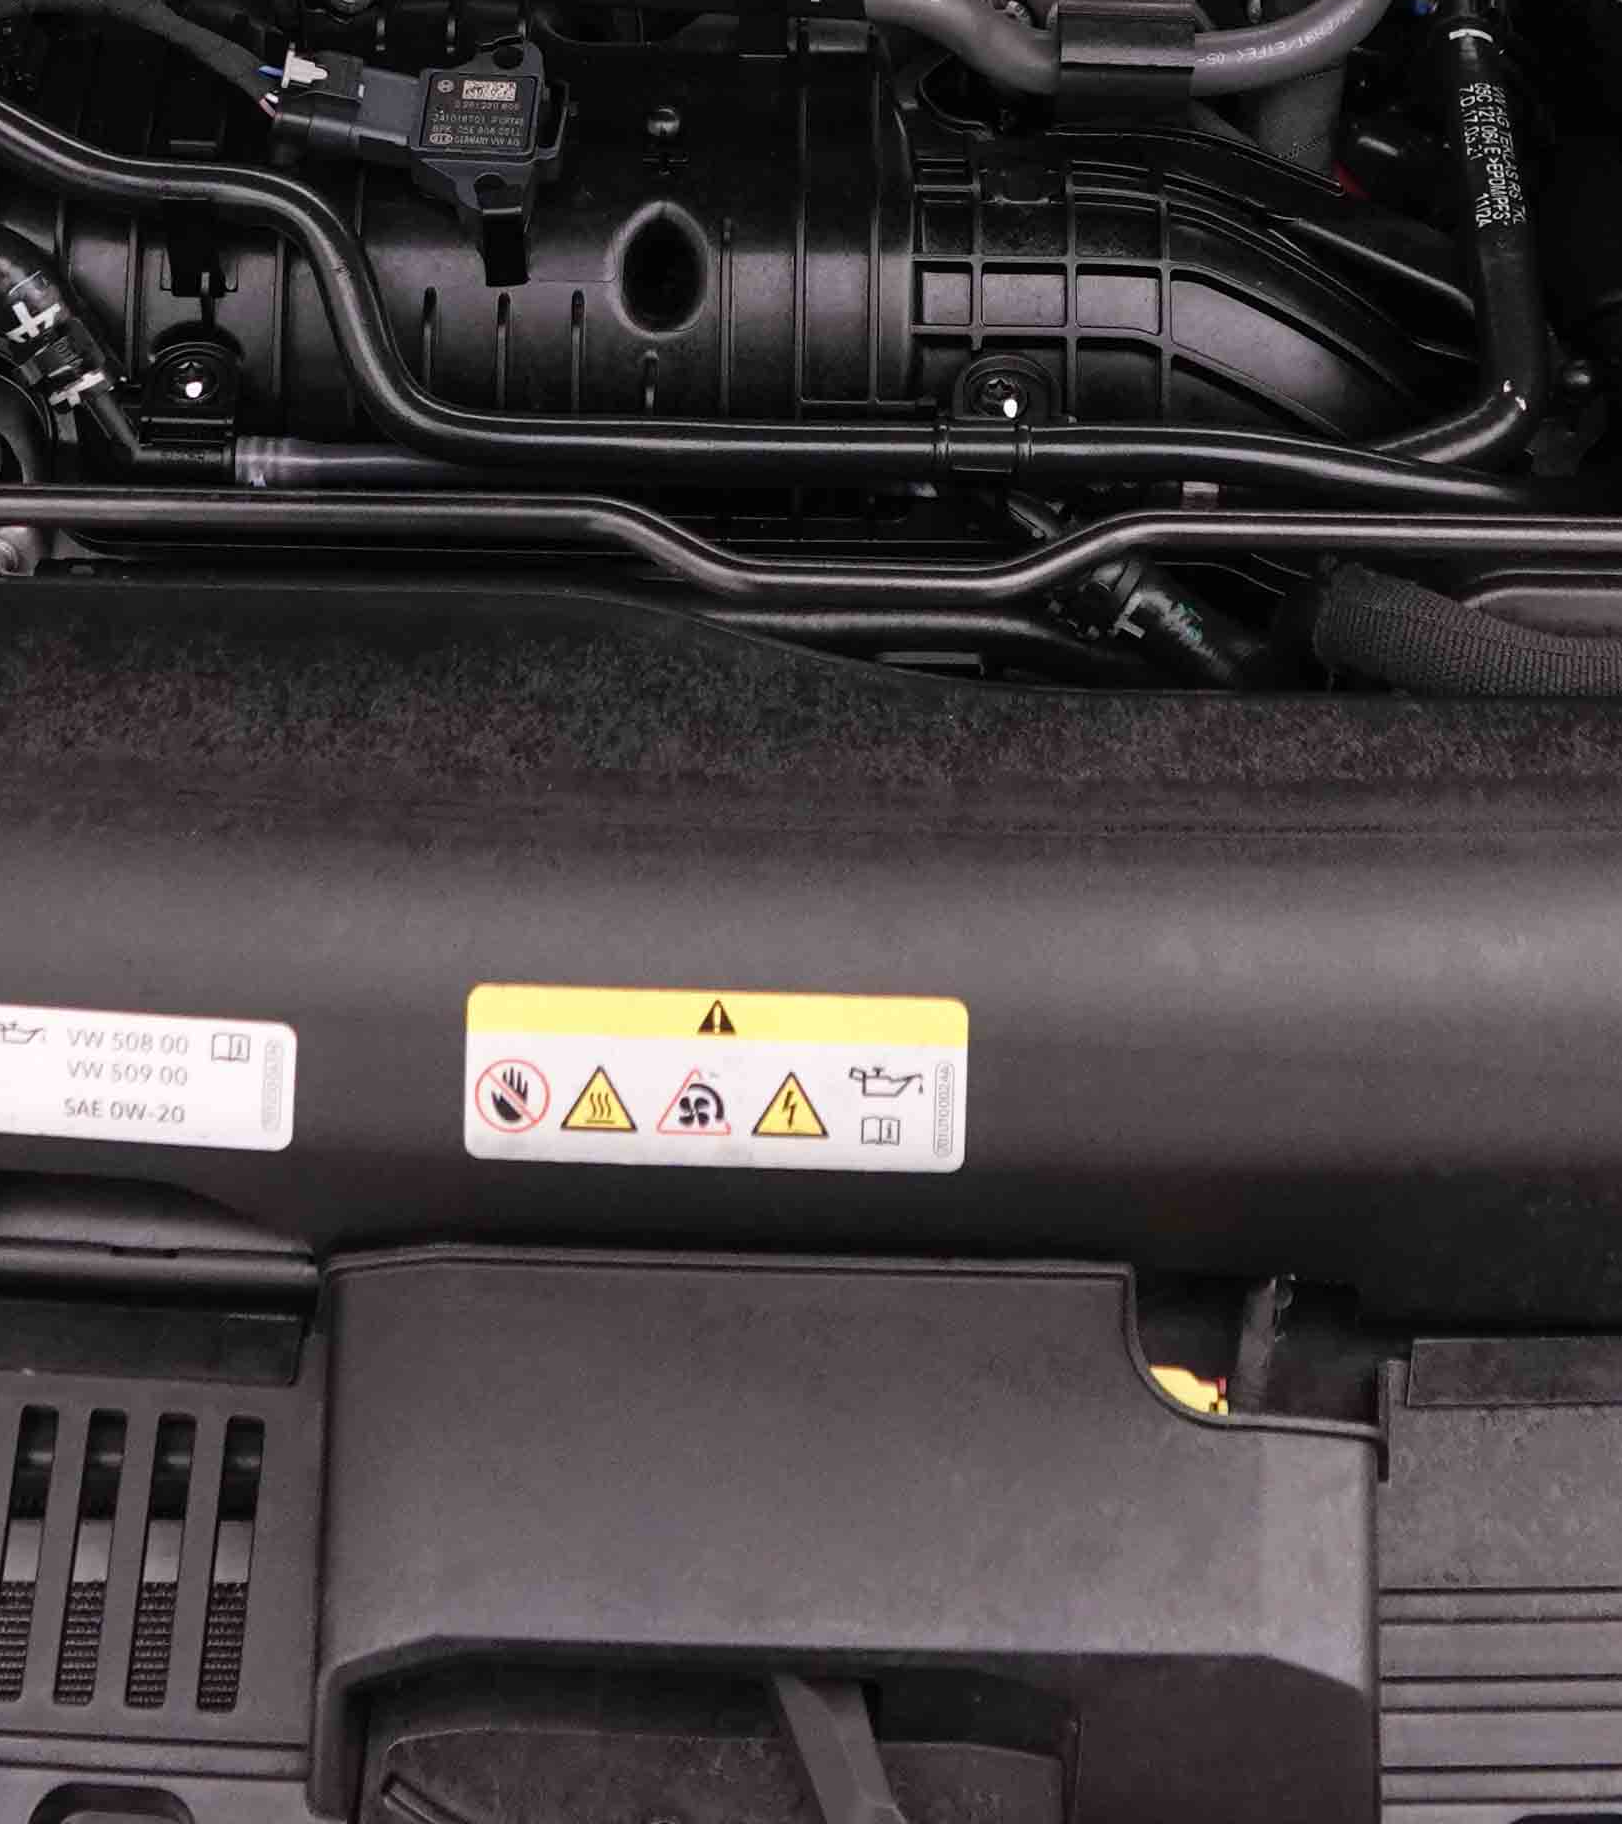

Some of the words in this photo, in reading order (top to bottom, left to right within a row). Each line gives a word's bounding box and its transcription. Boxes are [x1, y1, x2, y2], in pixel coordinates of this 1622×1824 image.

[66, 1027, 106, 1049] VW
[110, 1030, 154, 1052] 508
[159, 1034, 191, 1056] 00
[66, 1060, 105, 1081] VW
[109, 1062, 153, 1085] 509
[158, 1065, 189, 1087] 00
[62, 1097, 102, 1119] SAE
[109, 1101, 187, 1124] 0W-20
